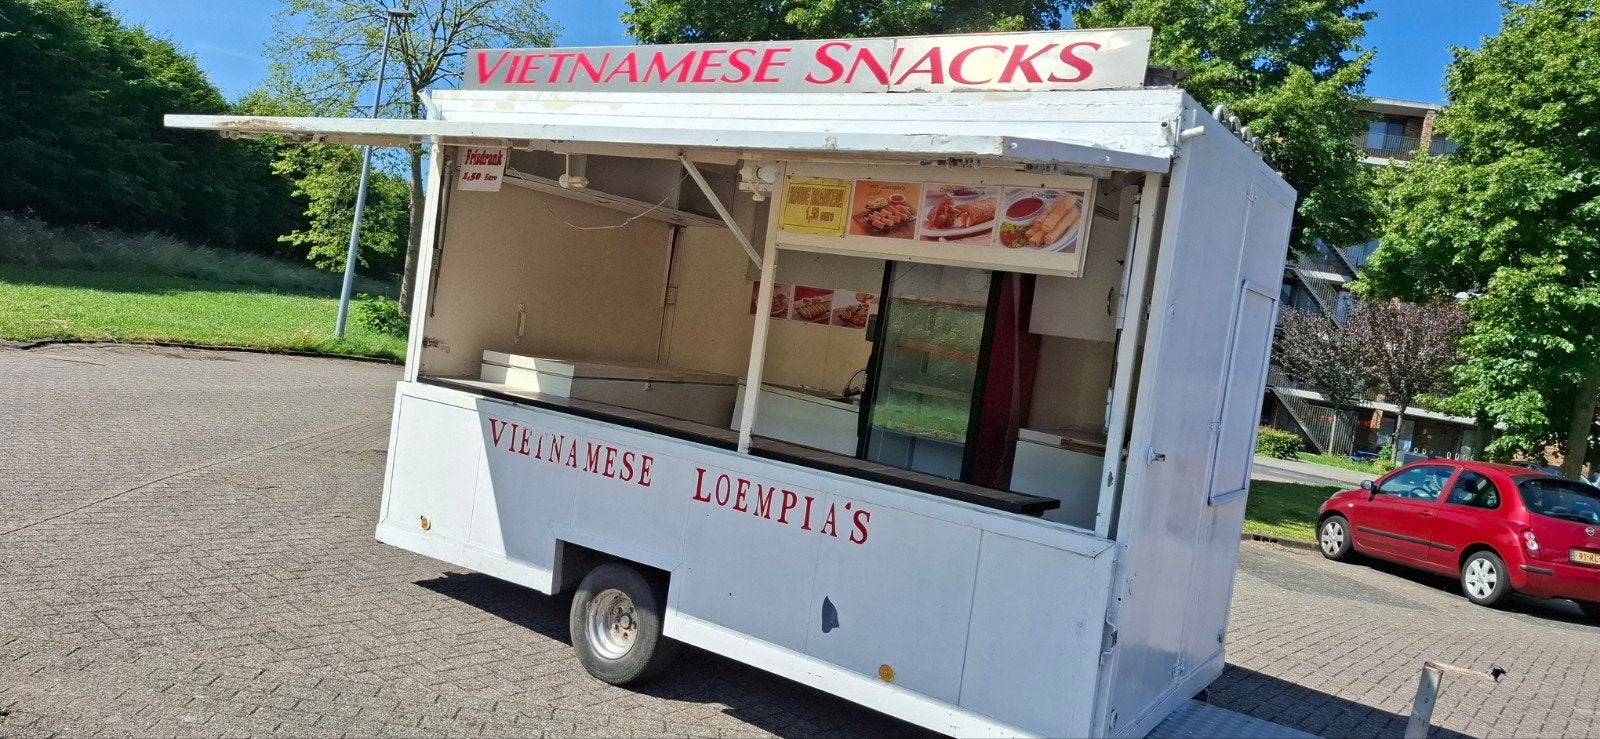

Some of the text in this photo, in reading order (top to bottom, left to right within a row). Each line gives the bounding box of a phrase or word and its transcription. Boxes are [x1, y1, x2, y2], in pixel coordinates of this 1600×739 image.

[476, 41, 1102, 85] VIETNAMESE SNACKS
[489, 417, 871, 545] VIETNAMESE LOEMPIA'S
